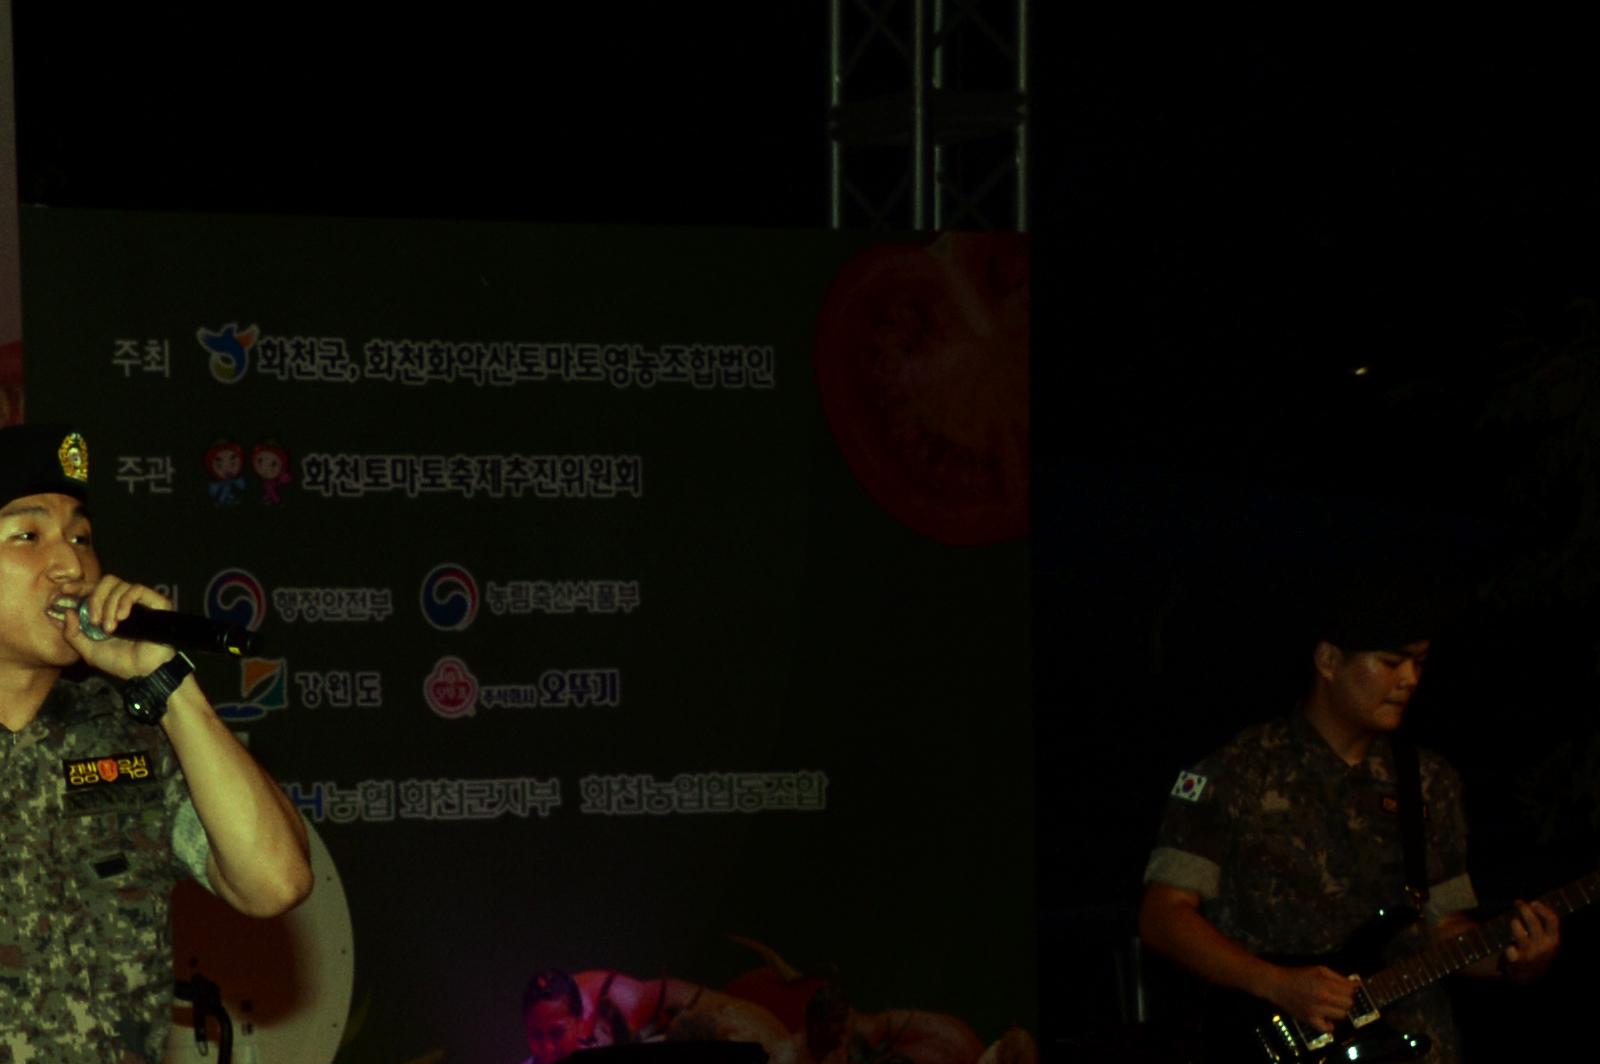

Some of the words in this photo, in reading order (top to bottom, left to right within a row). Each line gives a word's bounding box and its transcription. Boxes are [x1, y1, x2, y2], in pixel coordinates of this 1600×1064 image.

[111, 338, 172, 379] 주최
[256, 336, 361, 383] 화천군,
[363, 338, 776, 389] 화천화악산토마토영농조합법인
[114, 455, 177, 495] 주관
[300, 453, 643, 499] 화천토마토축제추진위원회
[272, 587, 395, 623] 행정안전부
[484, 579, 641, 615] 농림축산식품부
[294, 670, 383, 709] 강원도
[538, 667, 621, 707] 오뚜기
[400, 777, 562, 819] 화천군지부
[578, 770, 830, 815] 화천농업협동조합
